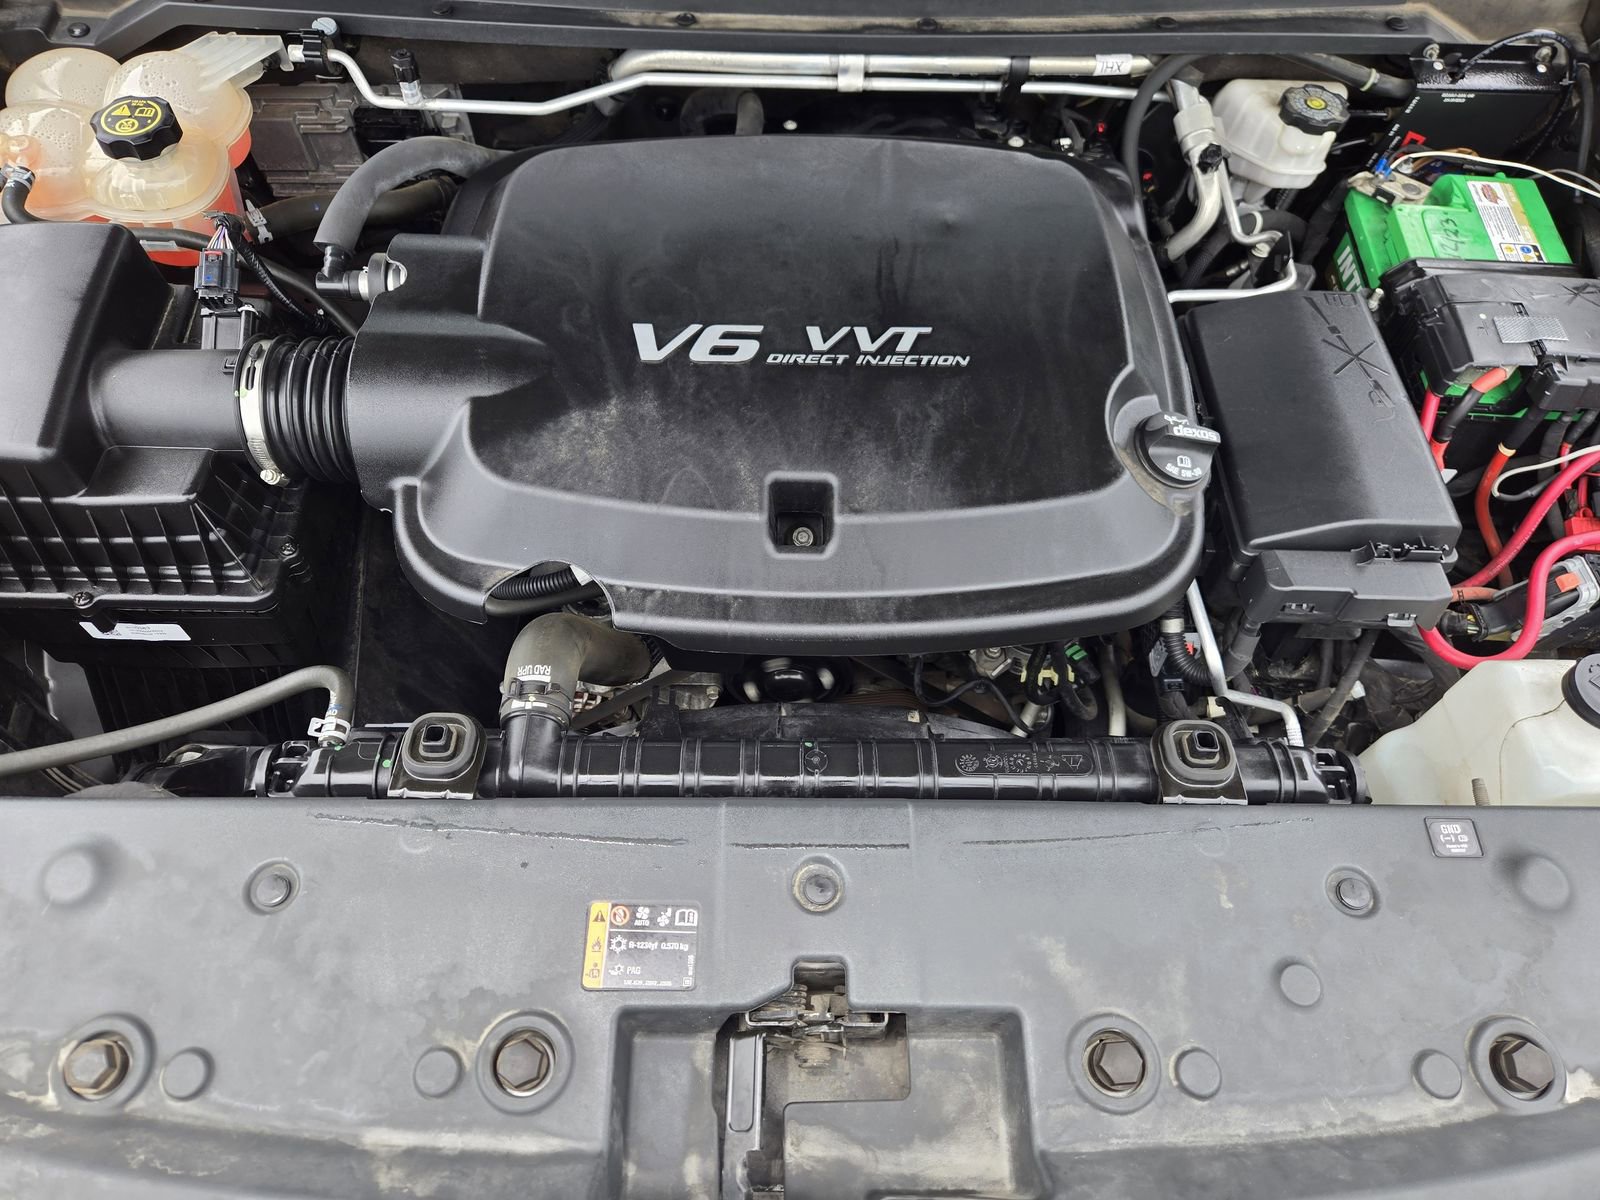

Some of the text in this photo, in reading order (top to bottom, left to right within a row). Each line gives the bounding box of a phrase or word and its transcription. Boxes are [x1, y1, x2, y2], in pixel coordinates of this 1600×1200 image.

[1337, 245, 1362, 292] INT
[632, 322, 933, 364] V6 VVT
[766, 354, 971, 367] DIRECT INJECTION
[1173, 424, 1217, 441] dexos
[517, 664, 552, 677] RAD UPR
[1440, 824, 1461, 834] GND
[626, 966, 641, 975] PAG
